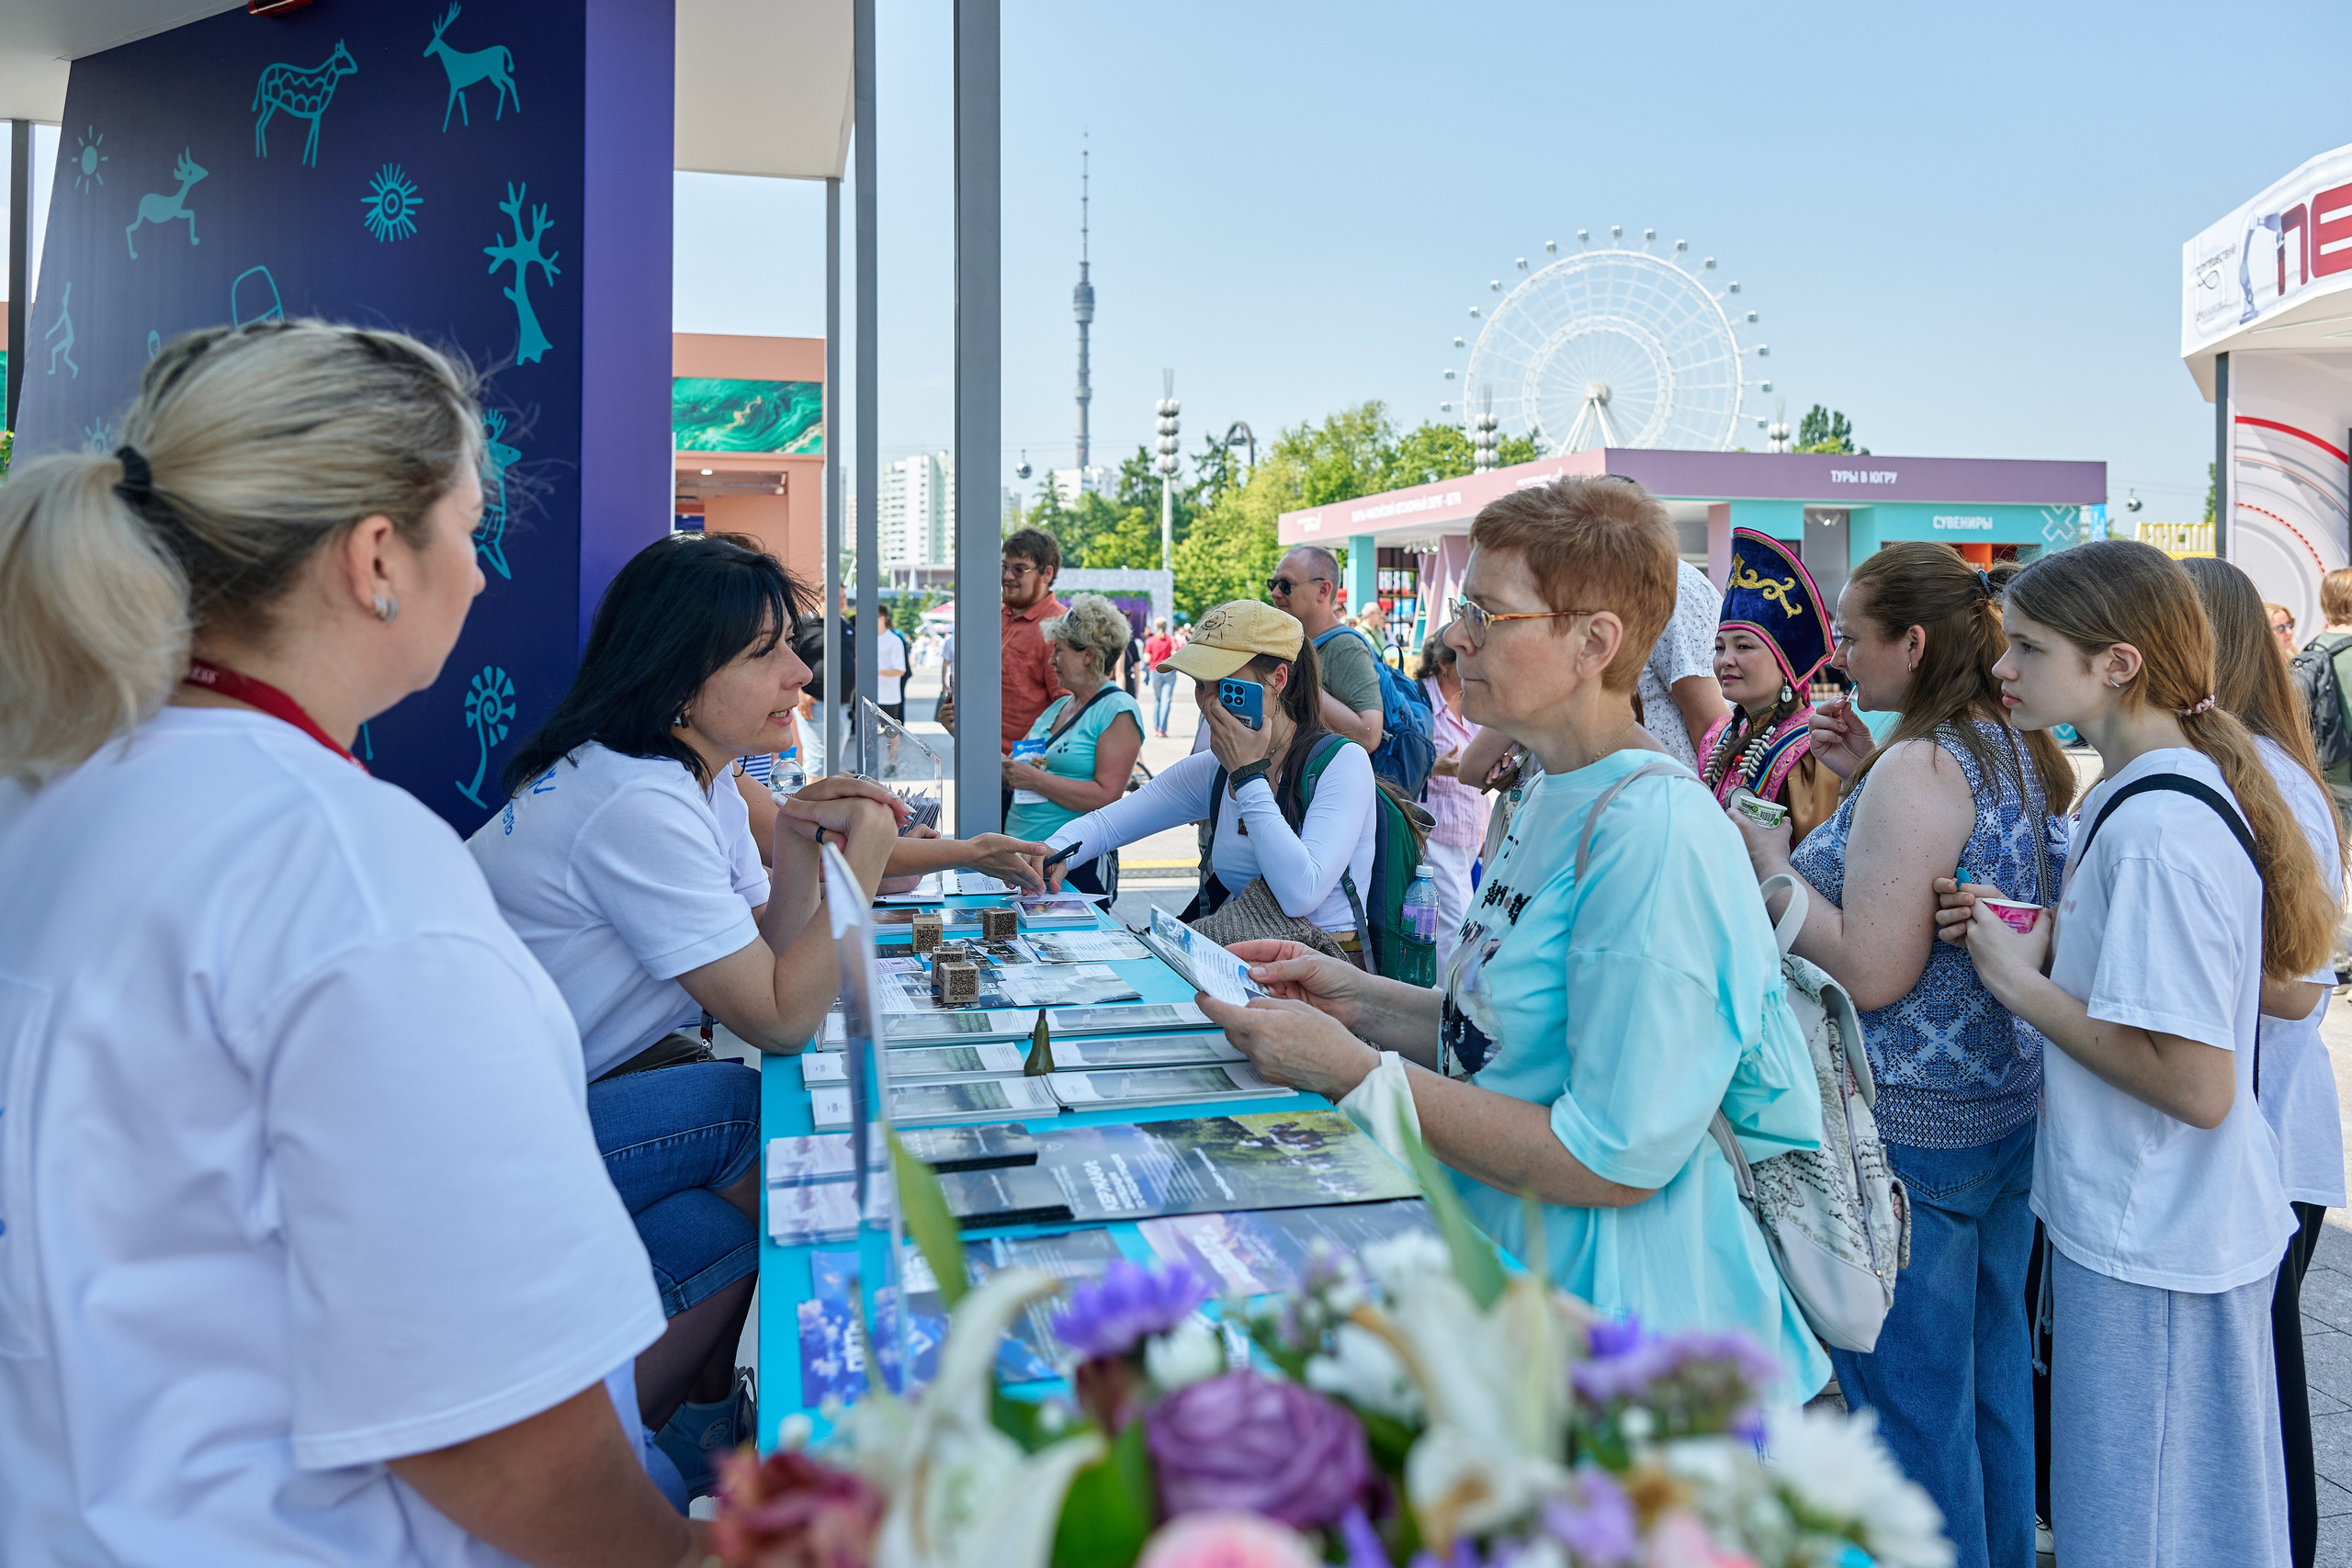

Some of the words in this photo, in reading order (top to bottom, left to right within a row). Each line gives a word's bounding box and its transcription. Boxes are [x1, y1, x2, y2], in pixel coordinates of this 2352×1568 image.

[1830, 469, 1859, 483] ТУРЫ
[1860, 471, 1868, 484] В
[1869, 471, 1898, 484] ЮГРУ
[1932, 514, 1993, 530] СУВЕНИРЫ
